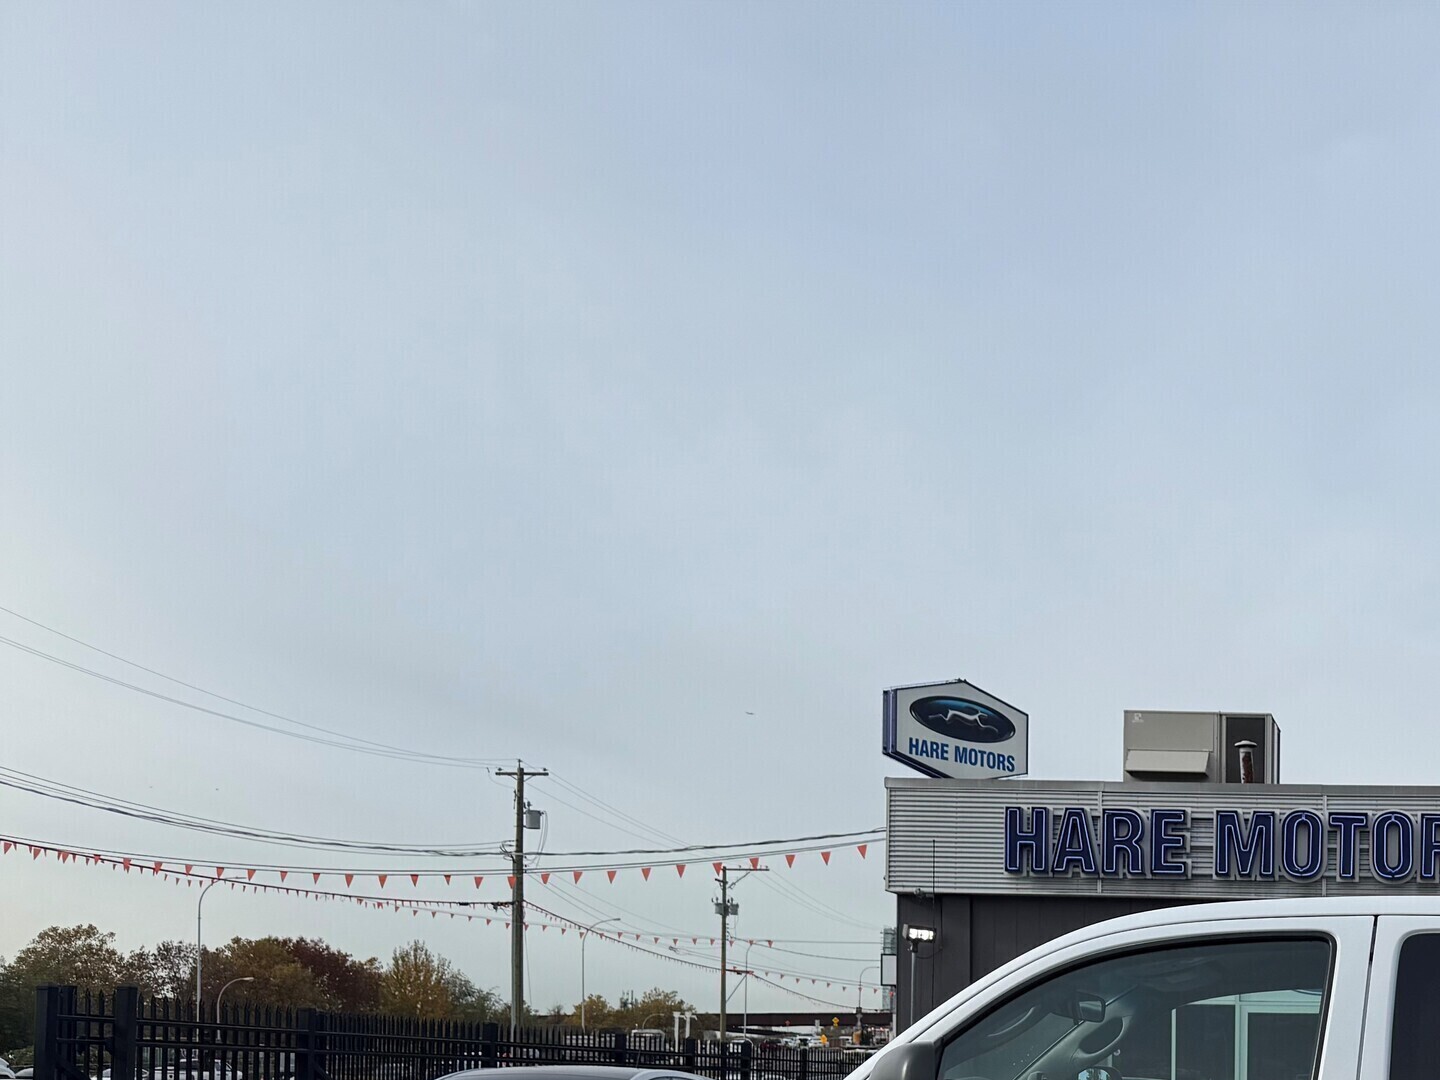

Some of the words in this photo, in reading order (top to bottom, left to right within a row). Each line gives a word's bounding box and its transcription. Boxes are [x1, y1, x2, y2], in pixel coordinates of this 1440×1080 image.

[908, 736, 950, 761] HARE
[954, 745, 1016, 773] MOTORS
[1004, 805, 1190, 880] HARE
